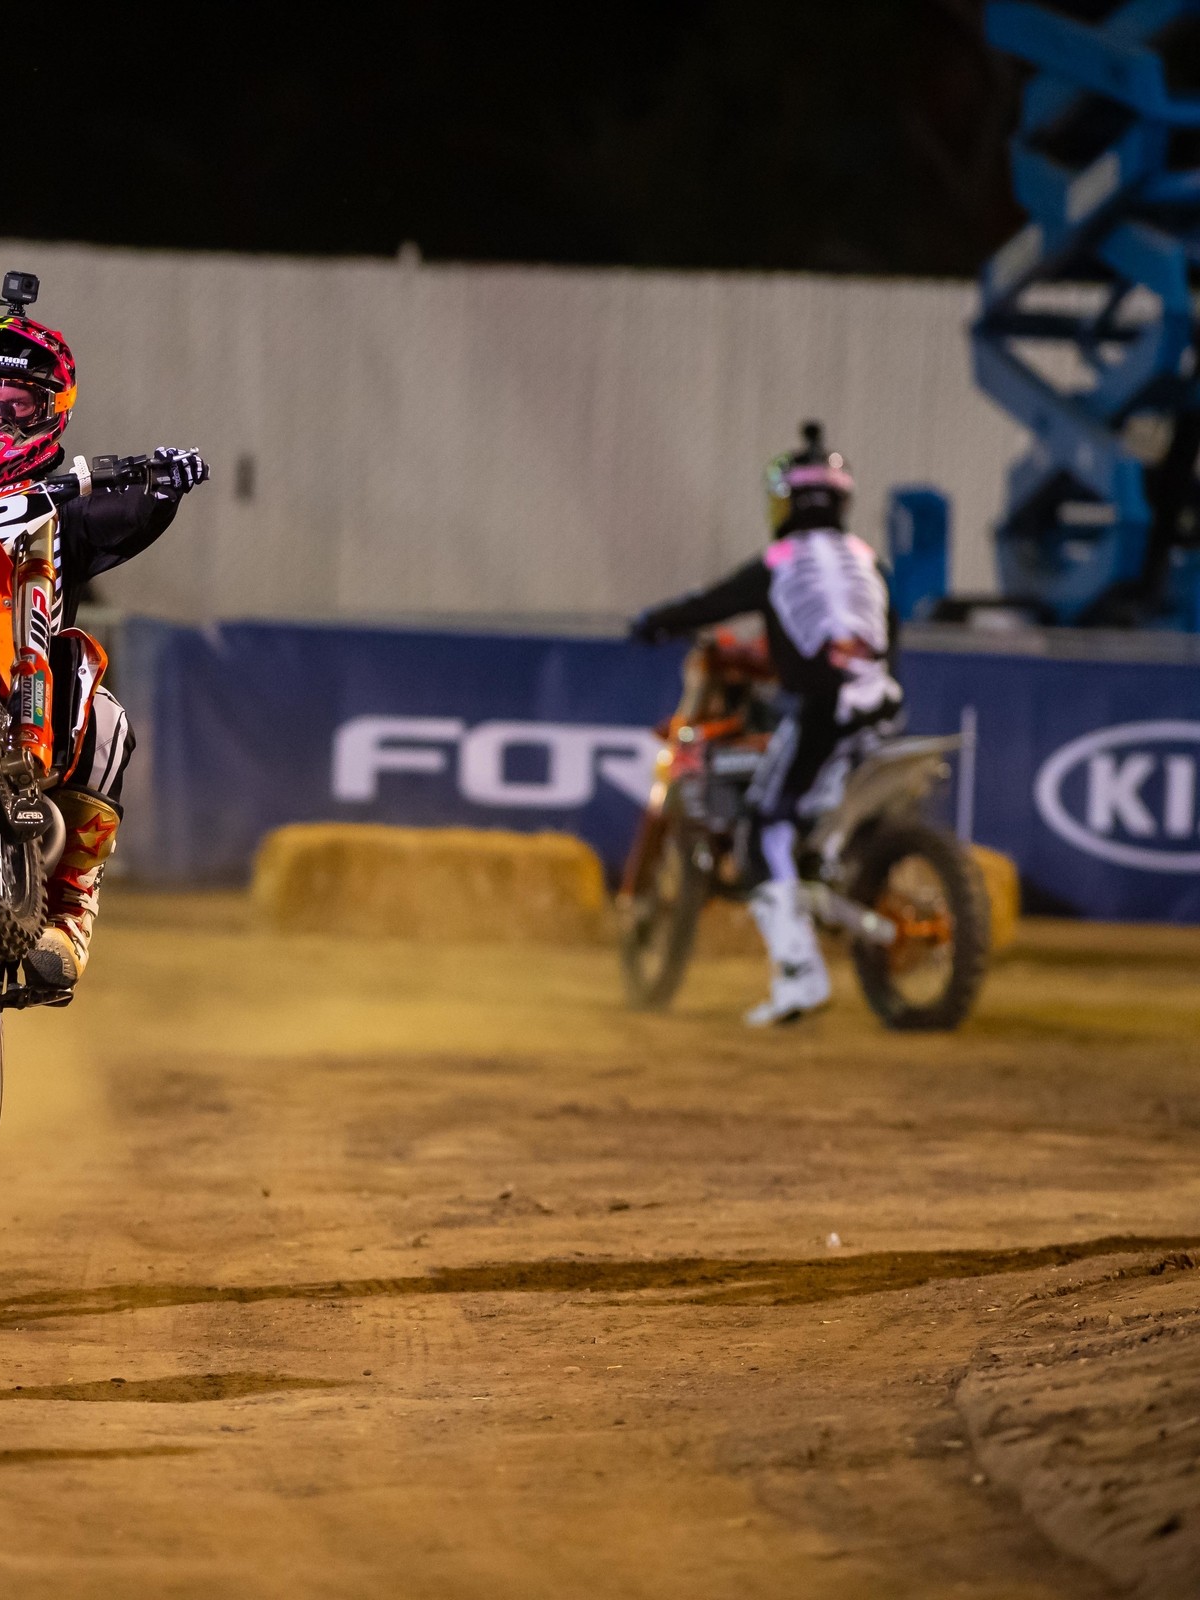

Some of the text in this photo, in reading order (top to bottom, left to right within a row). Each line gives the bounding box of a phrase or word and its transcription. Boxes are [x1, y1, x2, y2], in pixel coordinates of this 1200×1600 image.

[35, 679, 44, 708] MOTOREX
[333, 716, 668, 808] FOR
[1087, 752, 1200, 838] KI
